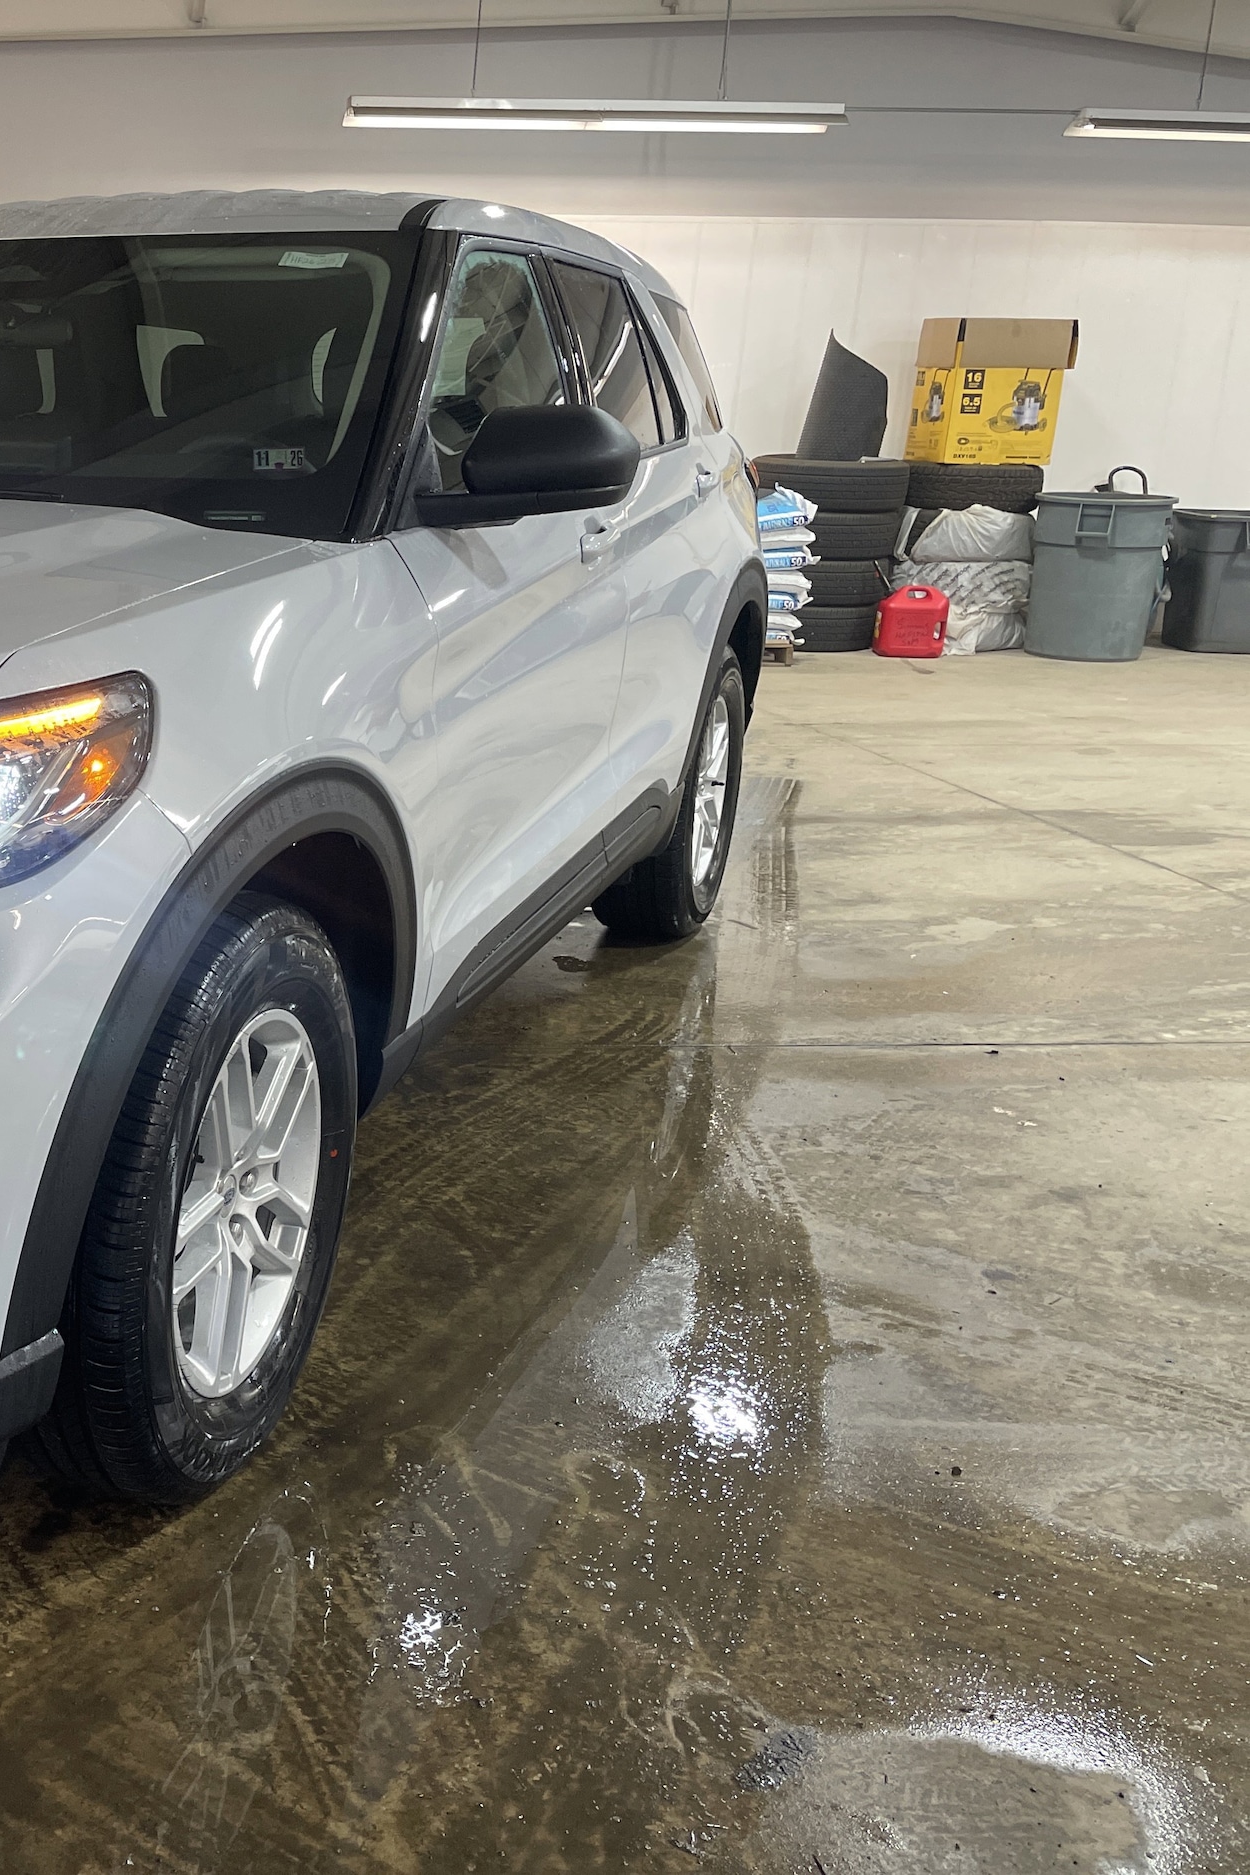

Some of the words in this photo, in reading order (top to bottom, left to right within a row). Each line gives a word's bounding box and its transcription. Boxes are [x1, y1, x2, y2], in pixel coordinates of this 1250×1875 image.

[967, 372, 982, 382] 16
[962, 397, 981, 406] 6.5
[291, 450, 303, 466] 26
[793, 516, 805, 526] 50
[791, 556, 803, 566] 50
[783, 600, 795, 610] 50
